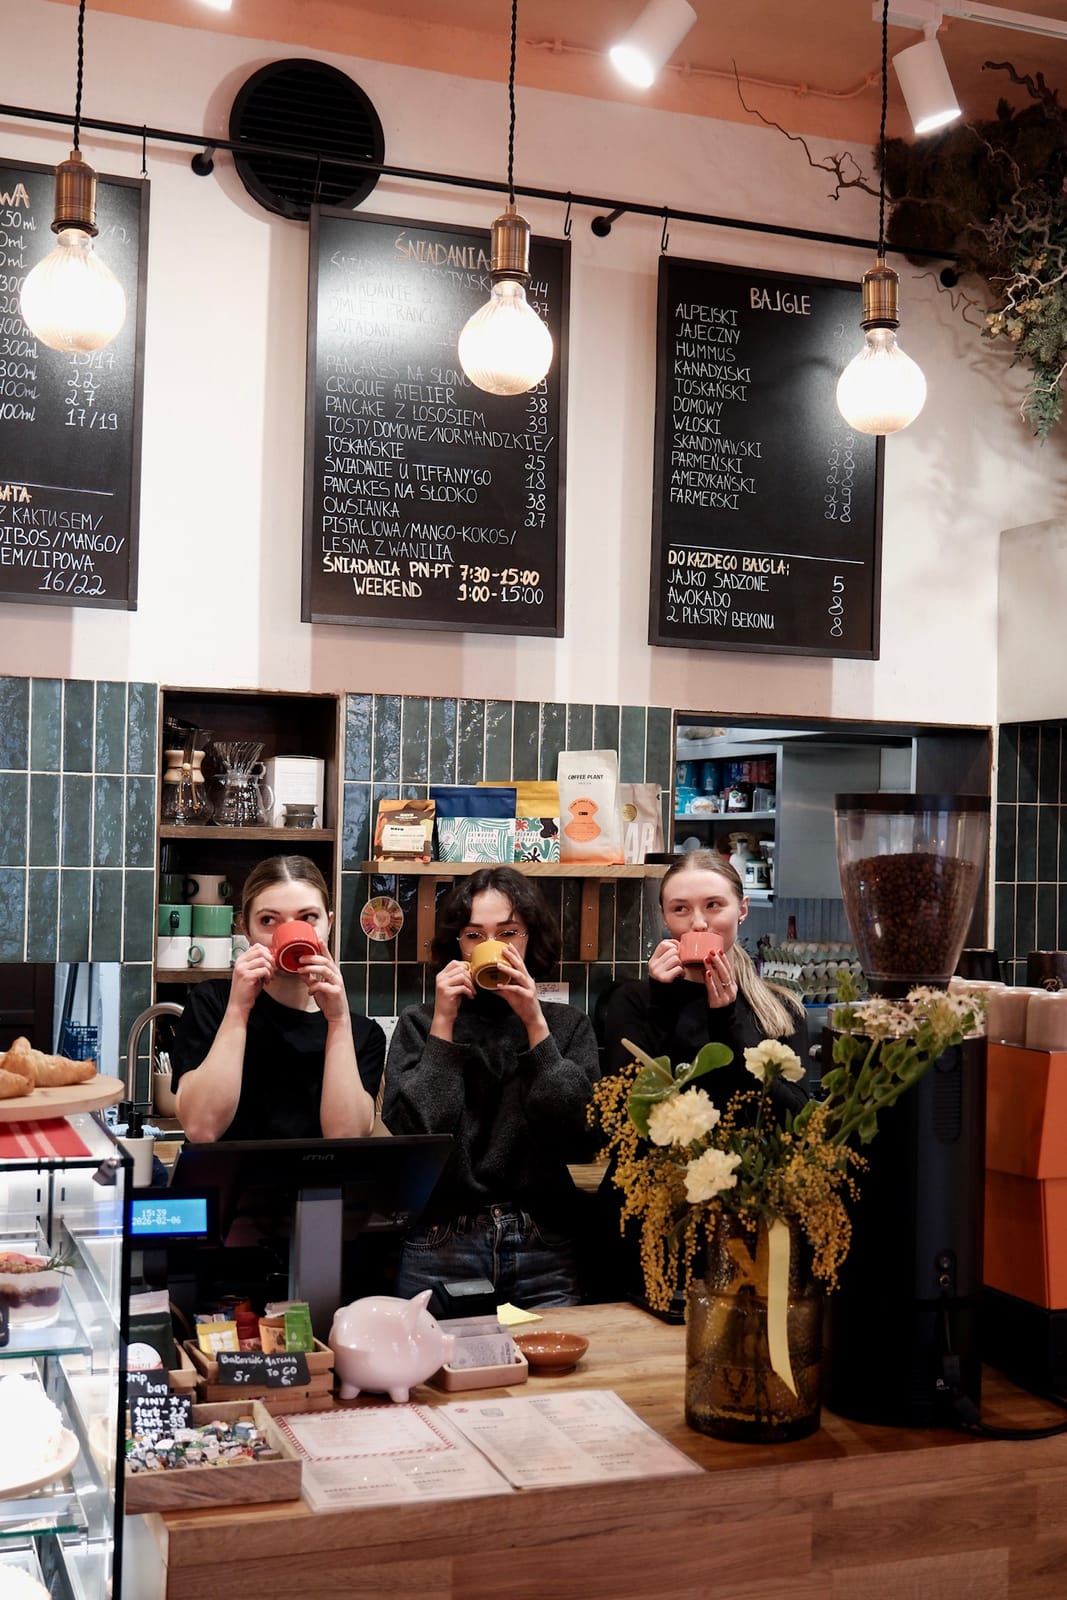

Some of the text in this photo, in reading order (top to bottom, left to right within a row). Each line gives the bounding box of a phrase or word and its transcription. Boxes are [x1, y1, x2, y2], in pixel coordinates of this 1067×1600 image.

[529, 280, 549, 299] 44
[750, 287, 811, 315] BAJGLE
[532, 301, 550, 317] 37
[675, 303, 739, 327] ALPEJSKI
[675, 322, 741, 345] JAJECZNY
[675, 340, 736, 362] HUMMUS
[67, 370, 101, 390] 22
[407, 366, 424, 382] NA
[674, 360, 752, 383] KANADYJSKI
[65, 389, 96, 407] 27
[325, 376, 548, 414] CROQUE ATELIER 38
[674, 377, 748, 402] TOSKAŃSKI
[325, 395, 386, 418] PANCAKE
[395, 403, 406, 419] Z
[527, 416, 548, 435] 39
[673, 396, 724, 417] DOMOWY
[64, 408, 119, 430] 17/19
[326, 416, 370, 435] TOSTY
[673, 414, 722, 435] WŁOSKI
[325, 435, 546, 471] TOSKAŃSKIE 25
[671, 451, 743, 474] PARMEŃSKI
[672, 433, 856, 470] SKANDYNAWSKI 28
[324, 453, 546, 490] ŚNIADANIE U TIFFANY'GO 18
[671, 469, 757, 494] AMERYKAŃSKI
[394, 483, 415, 500] NA
[420, 485, 478, 504] SŁODKO
[525, 494, 546, 511] 38
[670, 487, 852, 523] FARMERSKI 28
[12, 506, 104, 531] KAKTUSEM/
[323, 496, 546, 529] OWSIANKA 27
[374, 539, 386, 556] Z
[668, 550, 686, 567] DO
[322, 553, 401, 577] ŚNIADANIA
[409, 561, 454, 579] PN-PT
[38, 571, 107, 596] 16/22
[353, 577, 423, 598] WEEKEND
[667, 568, 845, 593] JAJKO SADZONE 5
[667, 586, 844, 616] AWOKADO 8
[666, 605, 844, 637] 2 PLASTRY BEKONU 8
[142, 1209, 167, 1217] 15:39
[282, 1366, 297, 1375] GO
